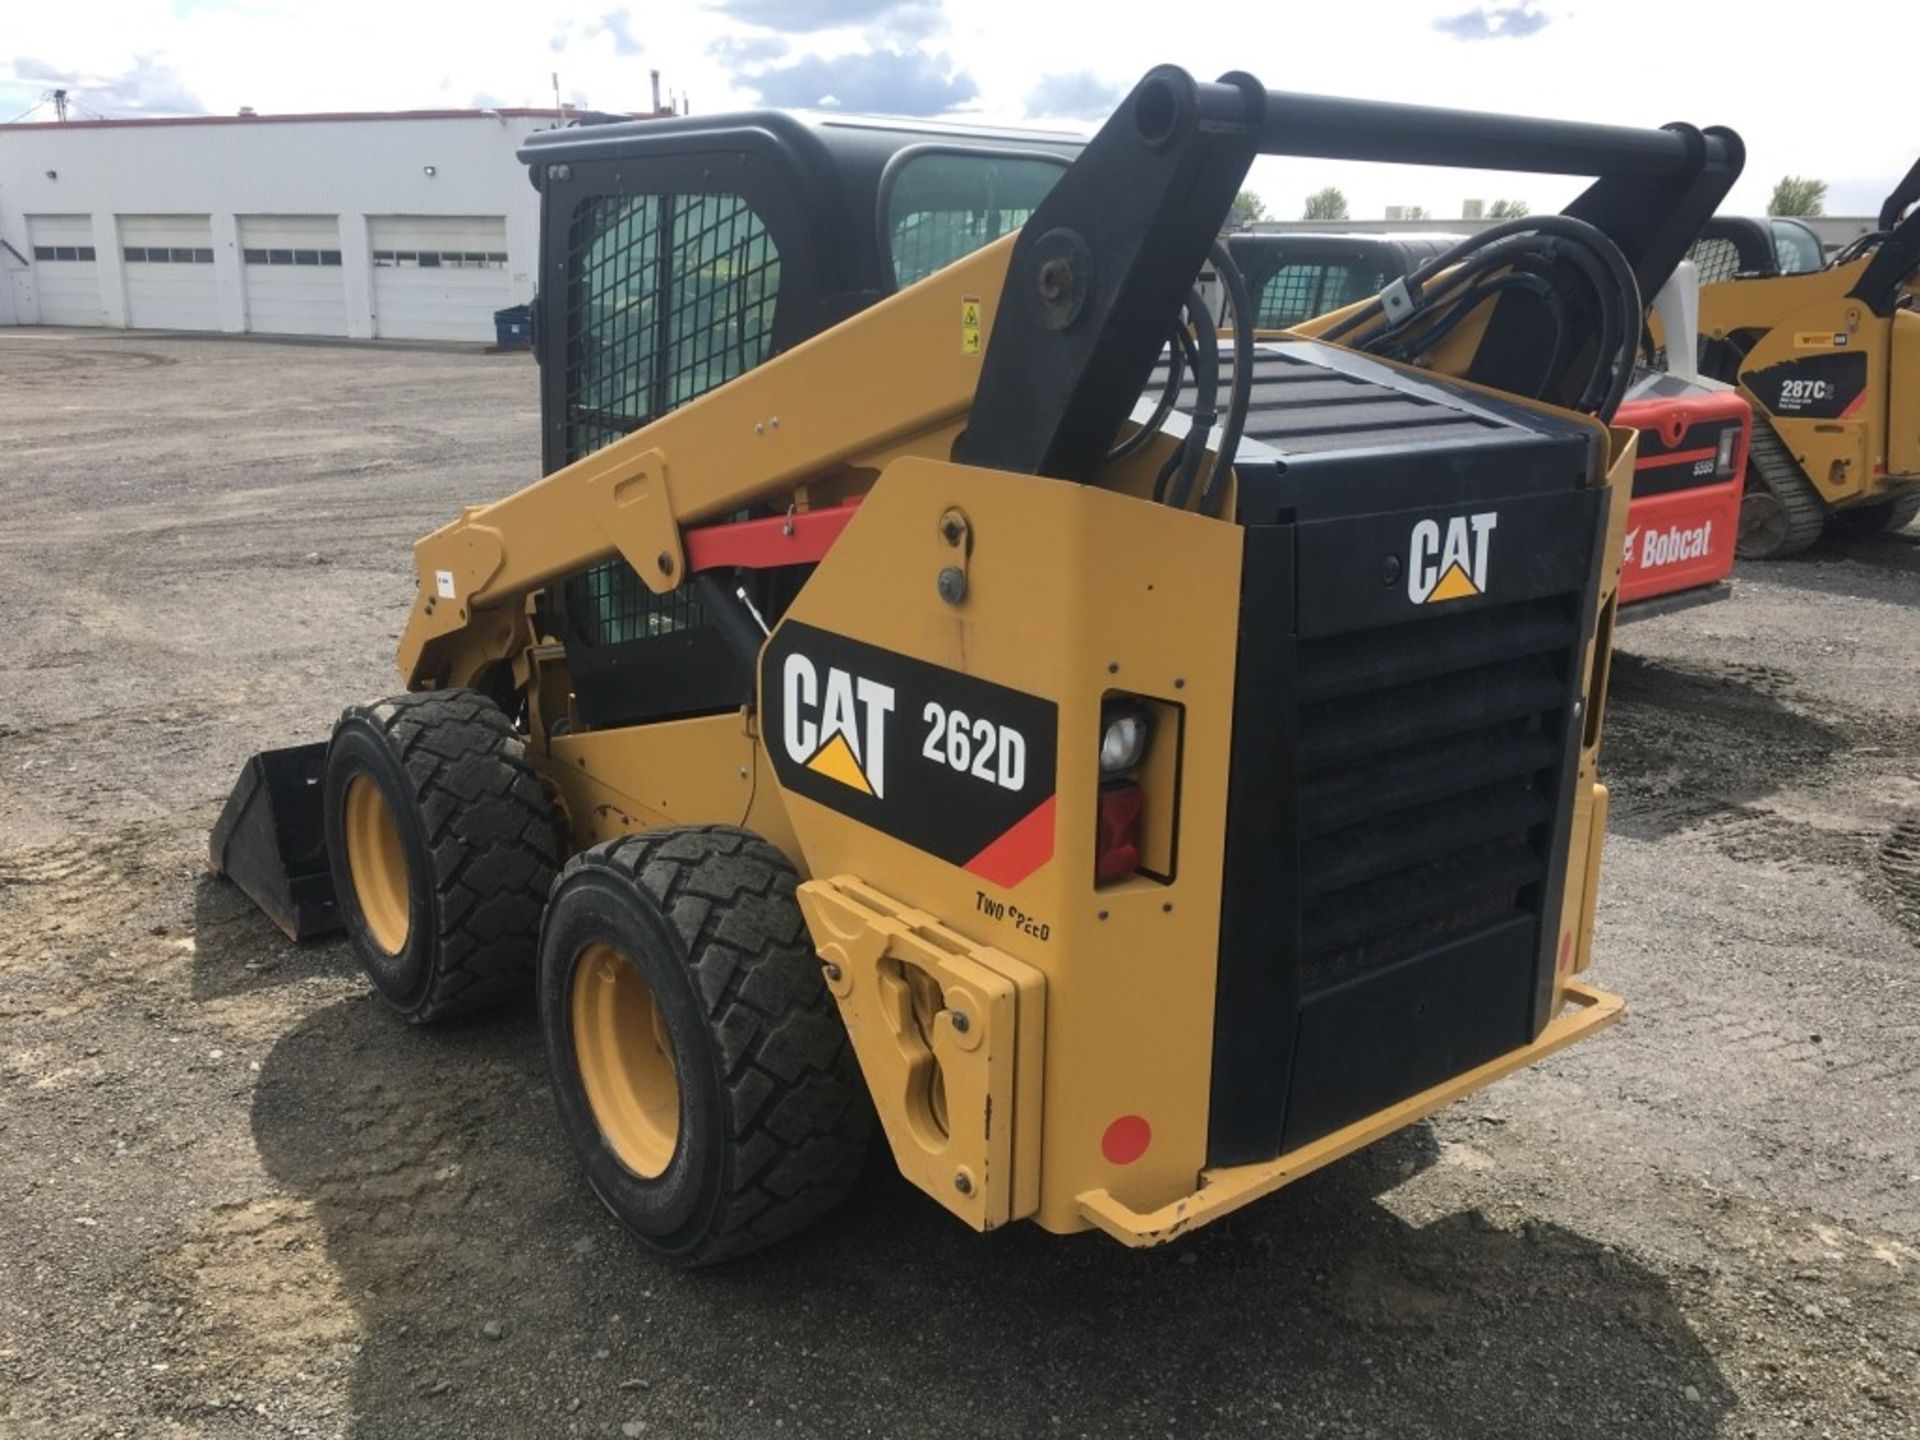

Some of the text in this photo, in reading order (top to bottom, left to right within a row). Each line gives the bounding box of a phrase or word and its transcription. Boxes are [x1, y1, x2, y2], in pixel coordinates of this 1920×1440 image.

[1408, 512, 1497, 604] CAT
[1641, 520, 1711, 569] Bobcat
[783, 653, 1026, 799] CAT 262D
